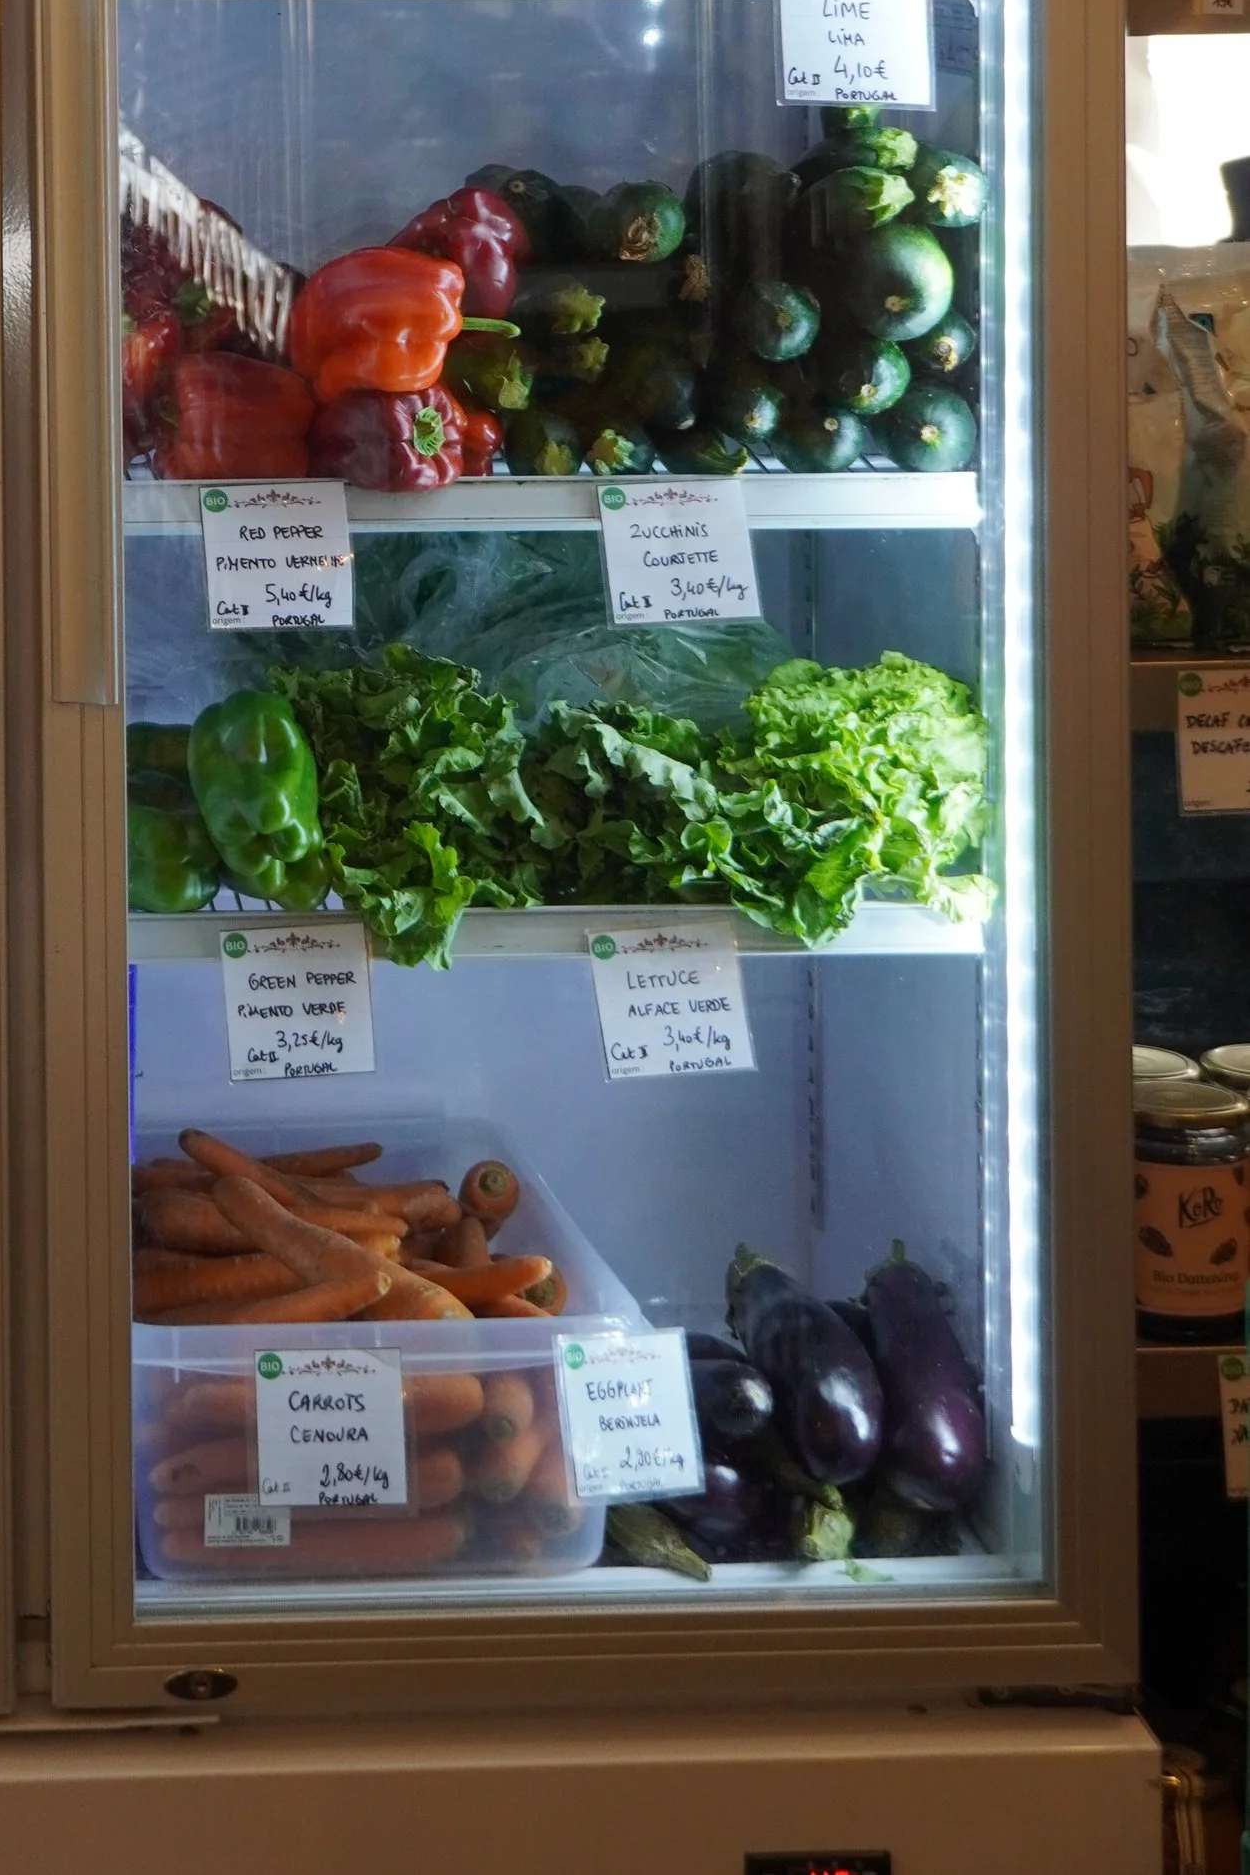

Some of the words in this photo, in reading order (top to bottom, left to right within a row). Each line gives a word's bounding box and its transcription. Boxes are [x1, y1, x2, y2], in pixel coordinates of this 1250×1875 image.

[834, 55, 888, 84] 4,10€
[836, 88, 897, 100] PORTUGAL
[206, 497, 225, 505] BIO
[604, 495, 623, 503] BIO
[240, 525, 266, 540] RED
[274, 525, 323, 539] PEPPER
[664, 607, 720, 619] PORTUGAL
[226, 941, 245, 950] BIO
[594, 943, 613, 951] BIO
[249, 973, 296, 990] GREEN
[306, 971, 357, 985] PEPPER
[627, 970, 701, 989] LETTUCE
[302, 1001, 346, 1016] VERDE
[628, 1001, 680, 1017] ALFACE
[689, 997, 731, 1013] VERDE
[669, 1057, 732, 1072] PORTUGAL
[260, 1362, 280, 1371] BIO
[289, 1390, 365, 1411] CARROTS
[290, 1425, 368, 1444] CENOURA
